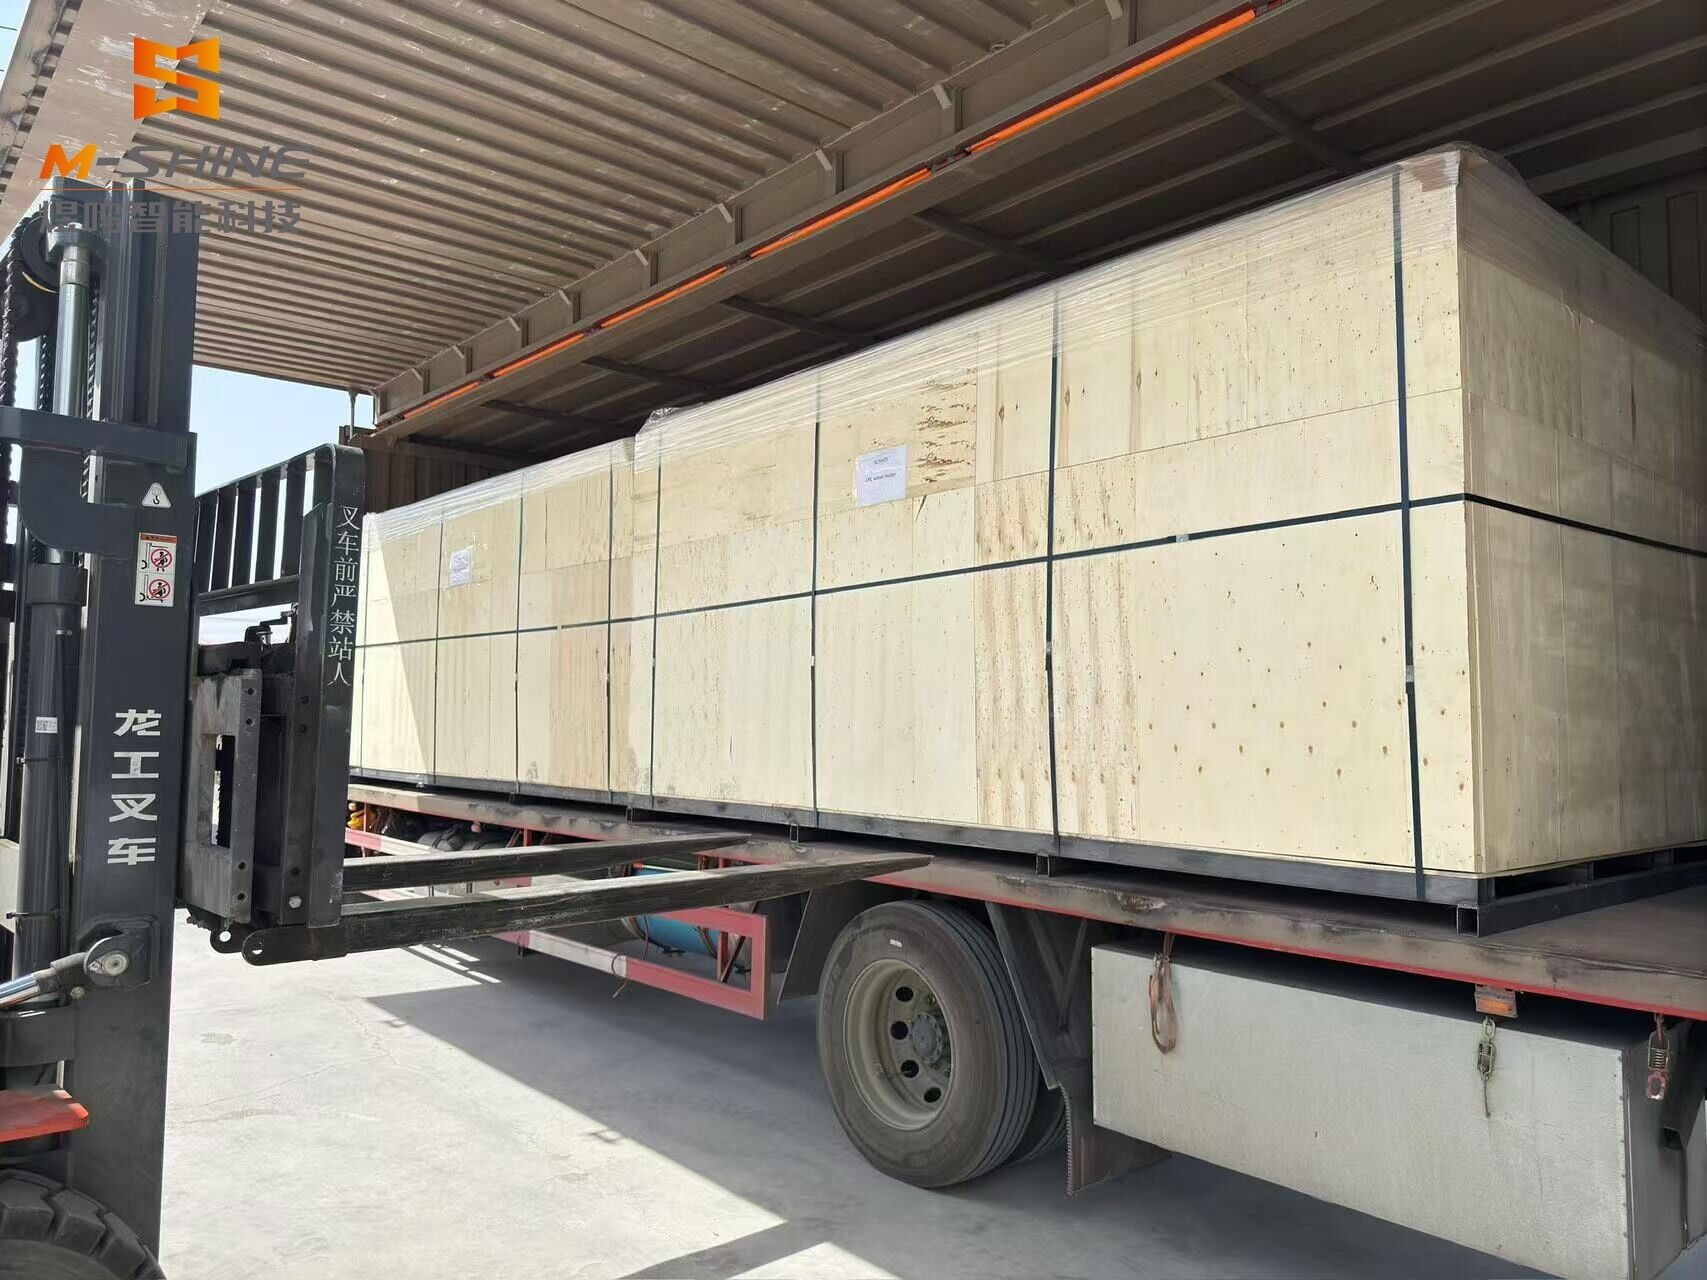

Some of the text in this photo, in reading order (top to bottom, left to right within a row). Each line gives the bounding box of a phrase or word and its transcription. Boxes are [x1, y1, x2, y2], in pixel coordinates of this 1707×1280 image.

[327, 505, 361, 687] 叉车前严禁站人
[107, 708, 162, 866] 龙工叉车
